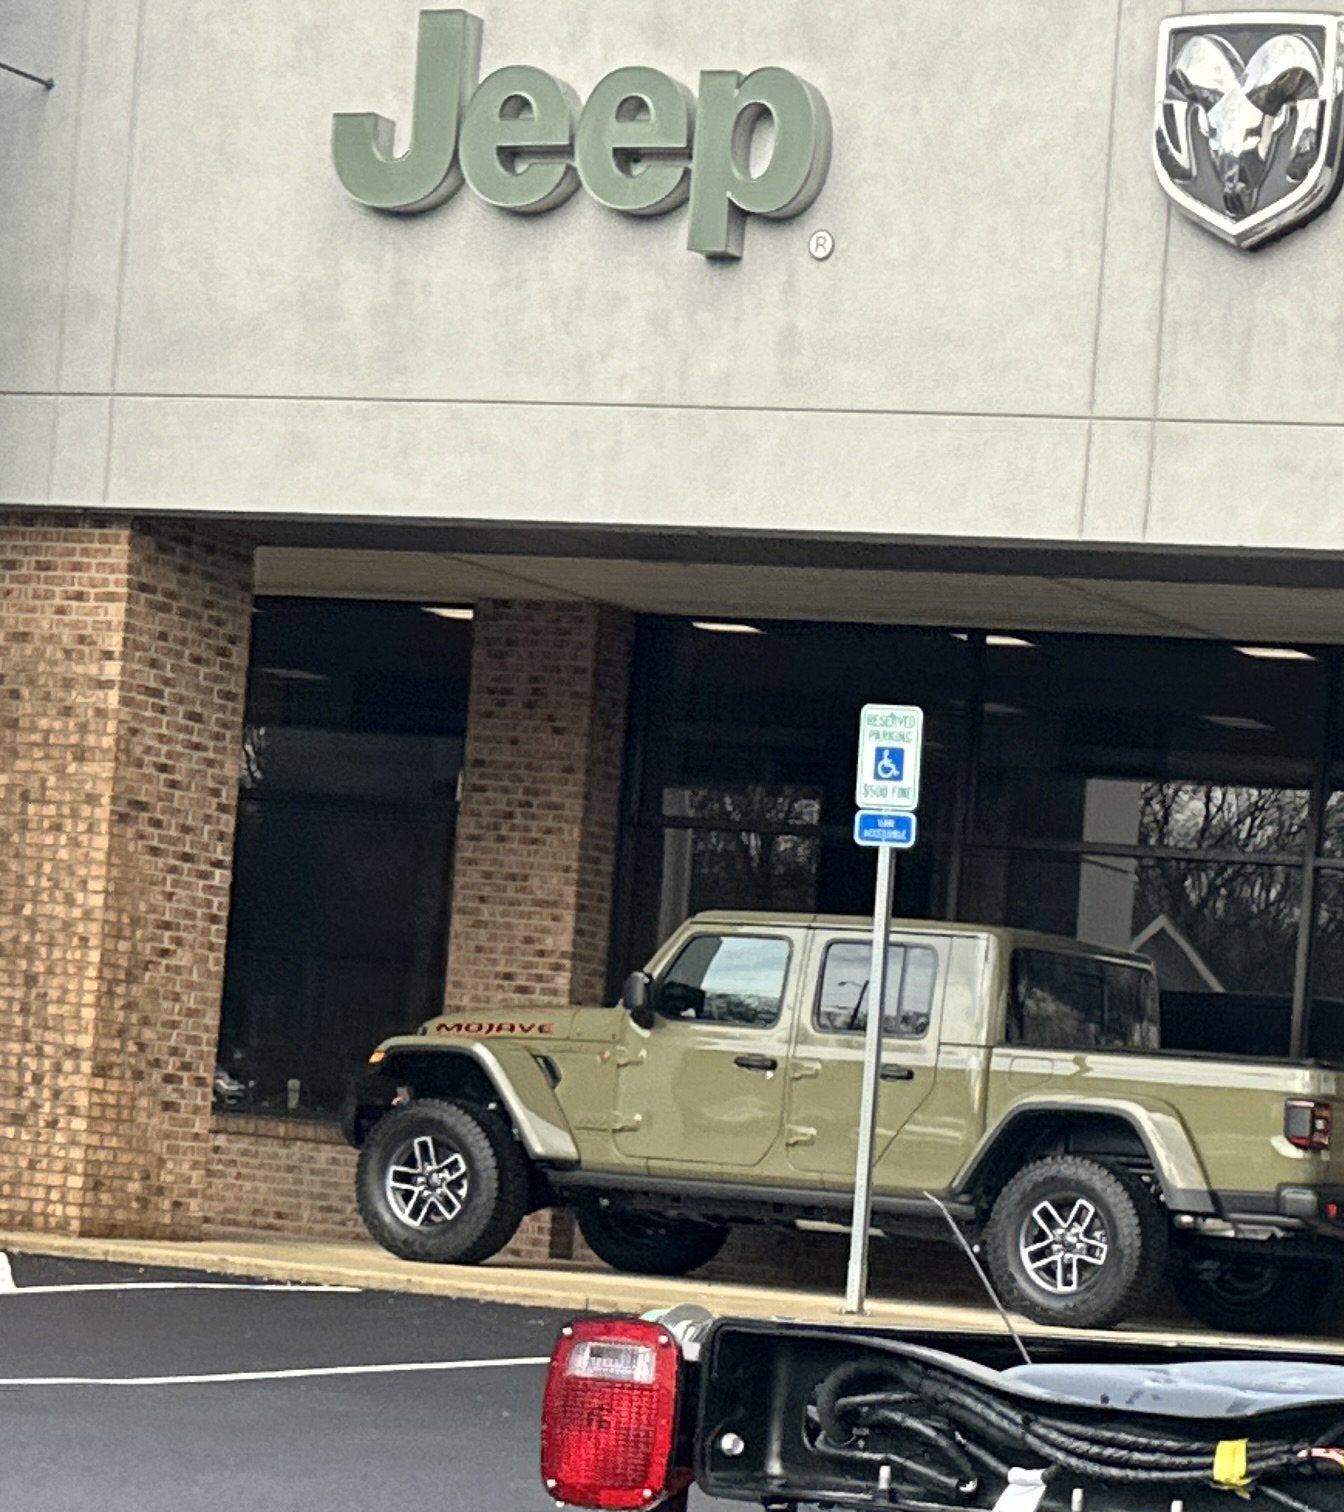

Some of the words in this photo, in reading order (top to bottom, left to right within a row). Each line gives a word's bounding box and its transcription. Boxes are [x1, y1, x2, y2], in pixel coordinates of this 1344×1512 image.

[331, 9, 833, 259] Jeep
[866, 712, 916, 729] RESERVED
[868, 729, 913, 744] PARKING
[435, 1022, 556, 1035] MOJAVE
